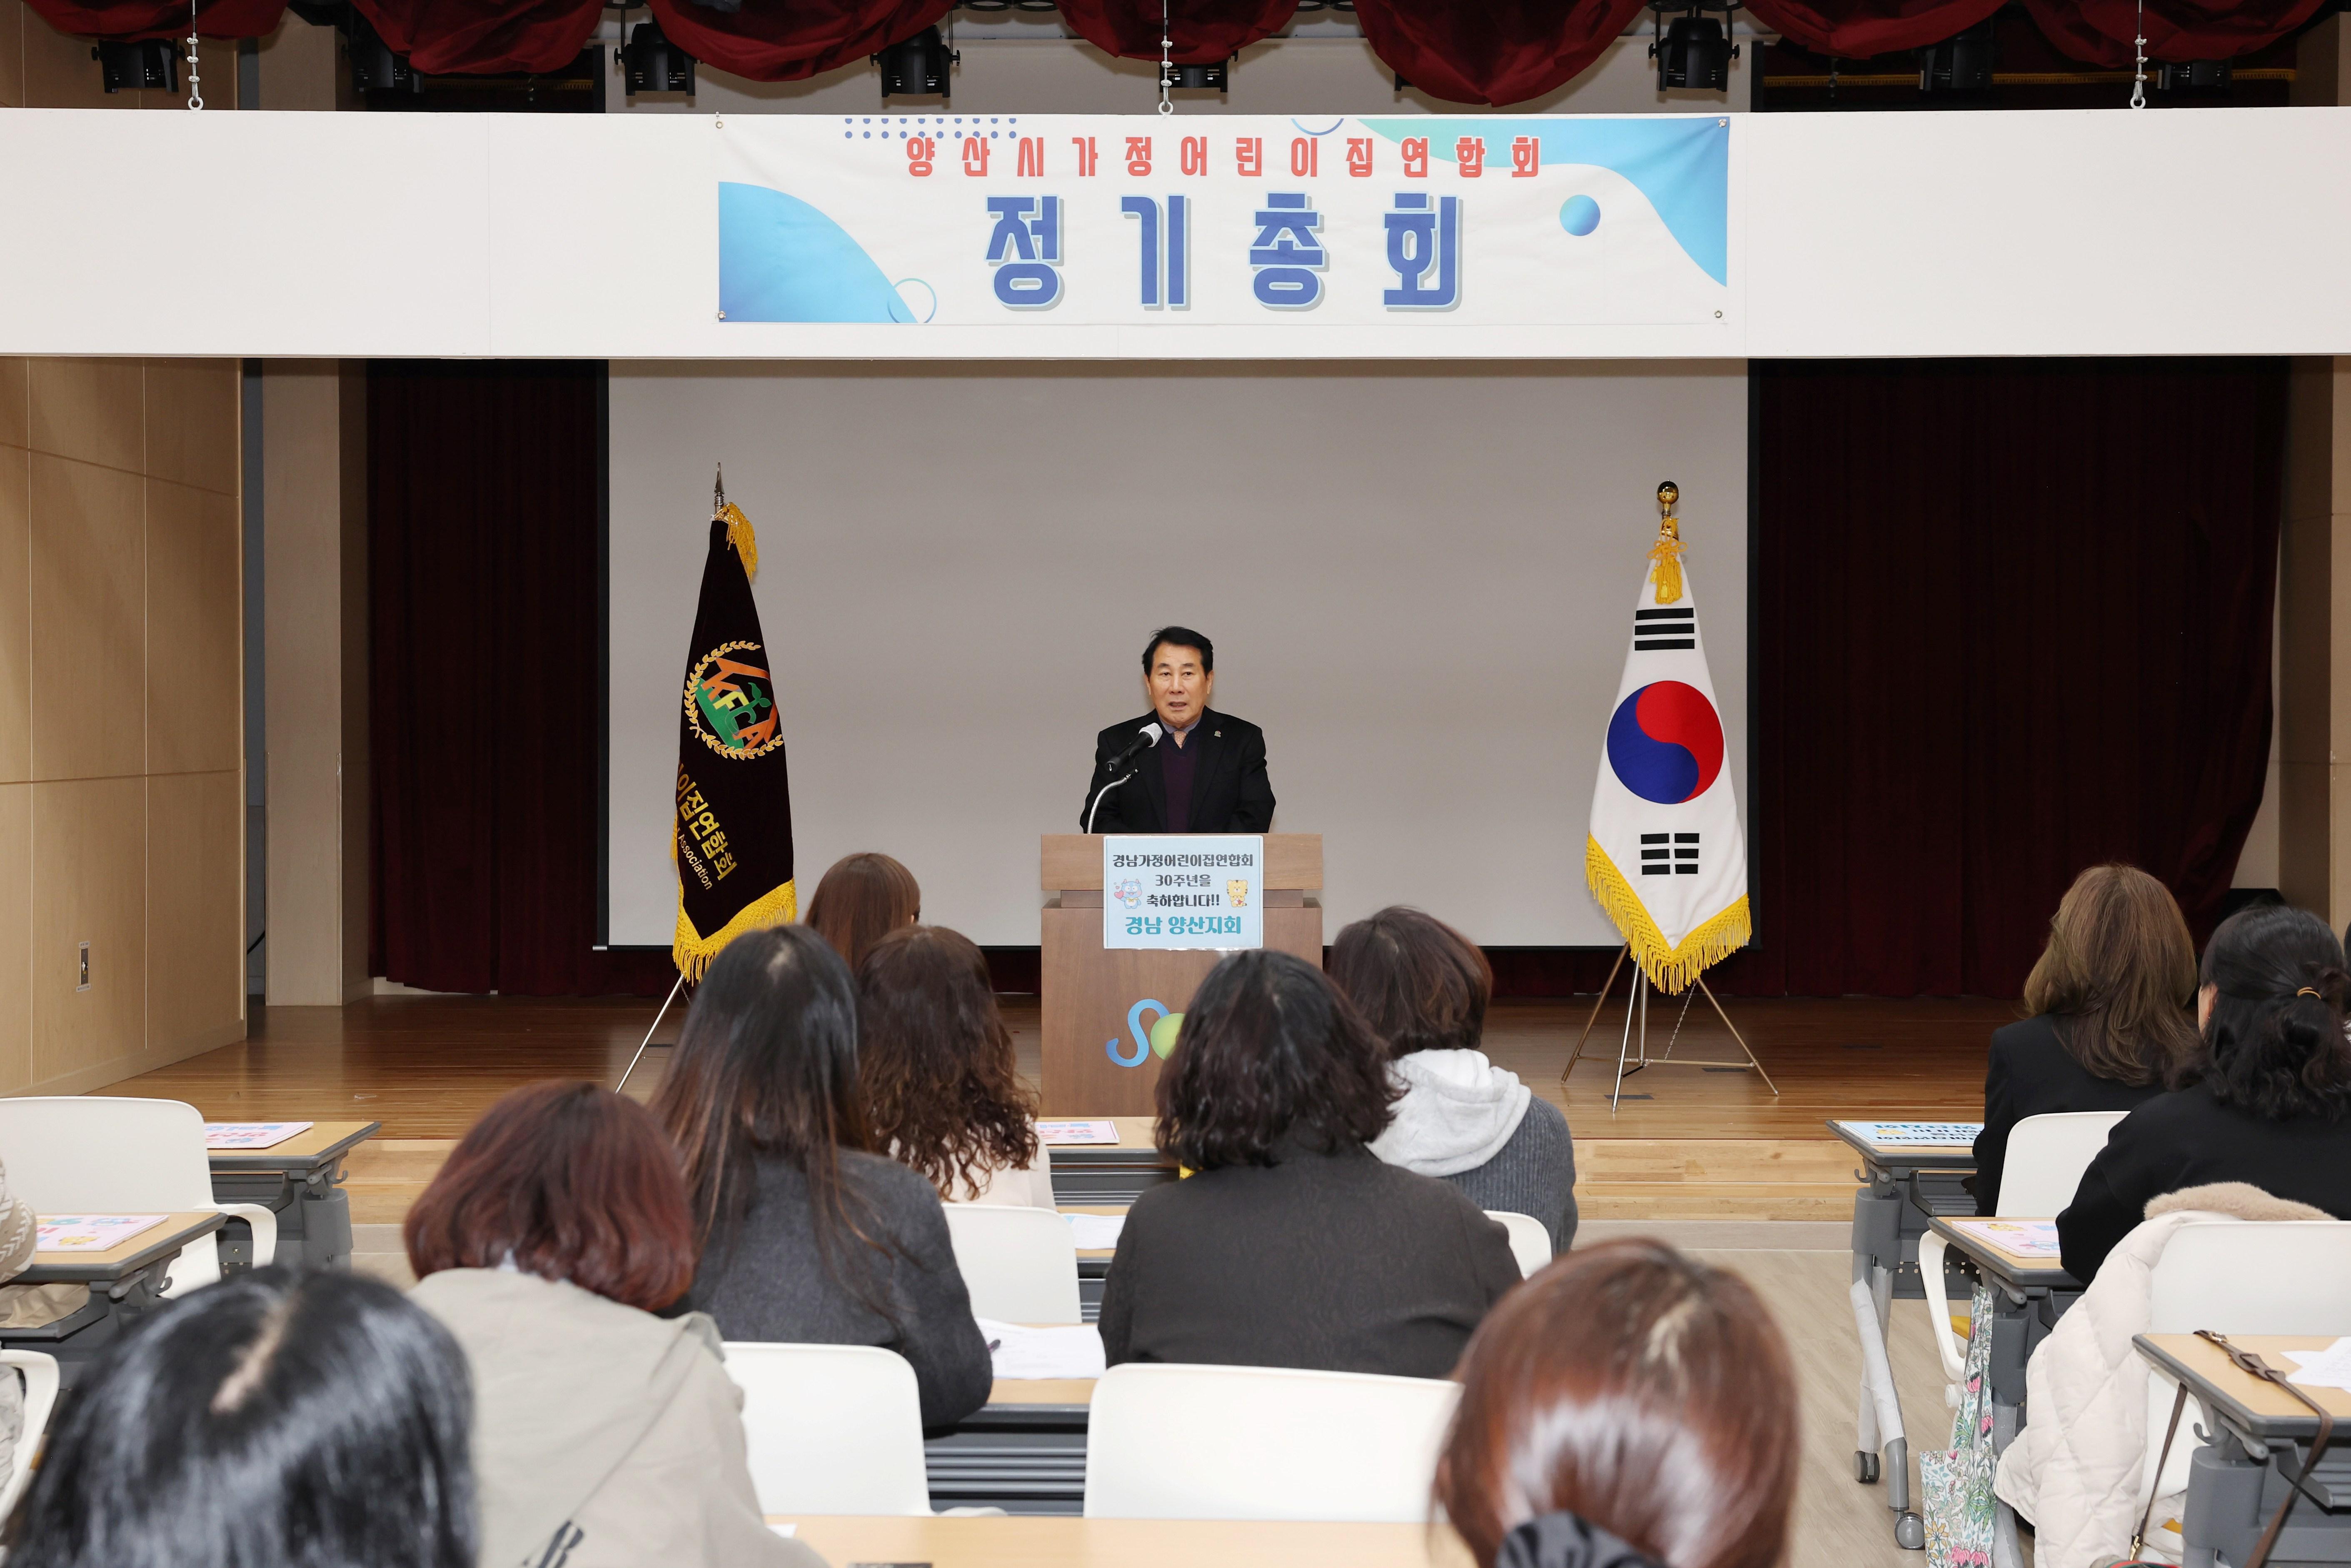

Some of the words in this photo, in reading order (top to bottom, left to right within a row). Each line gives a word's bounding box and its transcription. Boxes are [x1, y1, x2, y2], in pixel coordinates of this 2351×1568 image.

[907, 137, 1541, 177] 양산시가정어린이집연합회
[984, 192, 1463, 312] 정기총회
[678, 764, 738, 881] 이집연합회
[678, 834, 712, 889] Association
[1113, 854, 1253, 867] 경남가정어린이집연합회
[1155, 874, 1211, 887] 30주년을
[1146, 894, 1220, 907] 축하합니다!!
[1125, 916, 1163, 935] 경남
[1168, 916, 1241, 935] 양산지회
